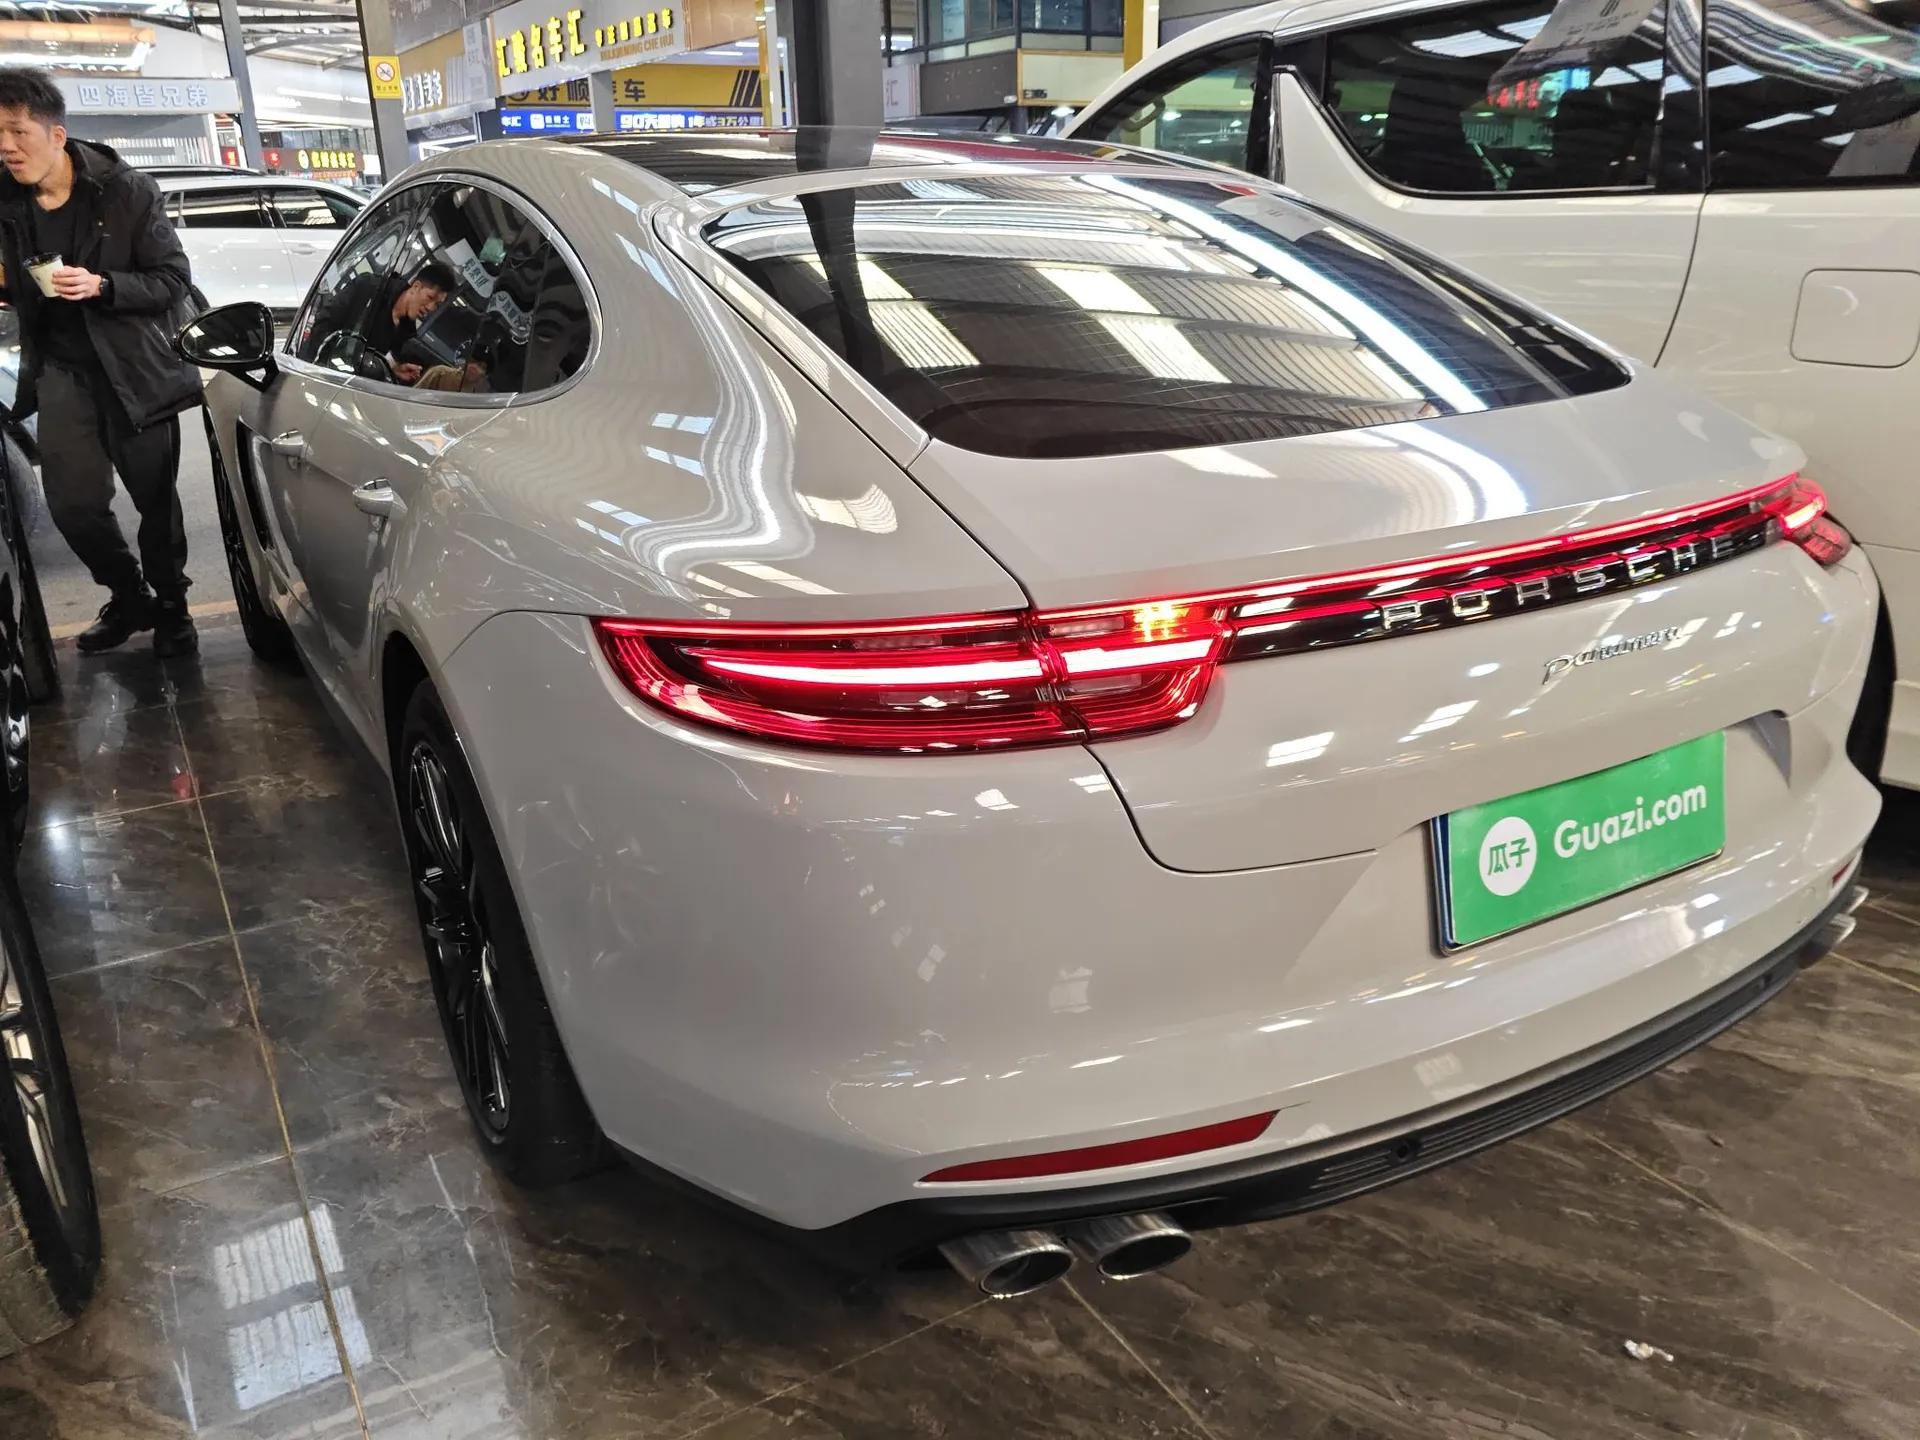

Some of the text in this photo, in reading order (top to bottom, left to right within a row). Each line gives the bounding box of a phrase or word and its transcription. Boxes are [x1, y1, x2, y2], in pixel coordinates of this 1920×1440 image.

[78, 84, 209, 107] 四海皆兄弟
[538, 79, 646, 102] 好顺车
[1382, 533, 1735, 630] PORSCHE
[1487, 784, 1707, 876] 瓜子 Guazi.com
